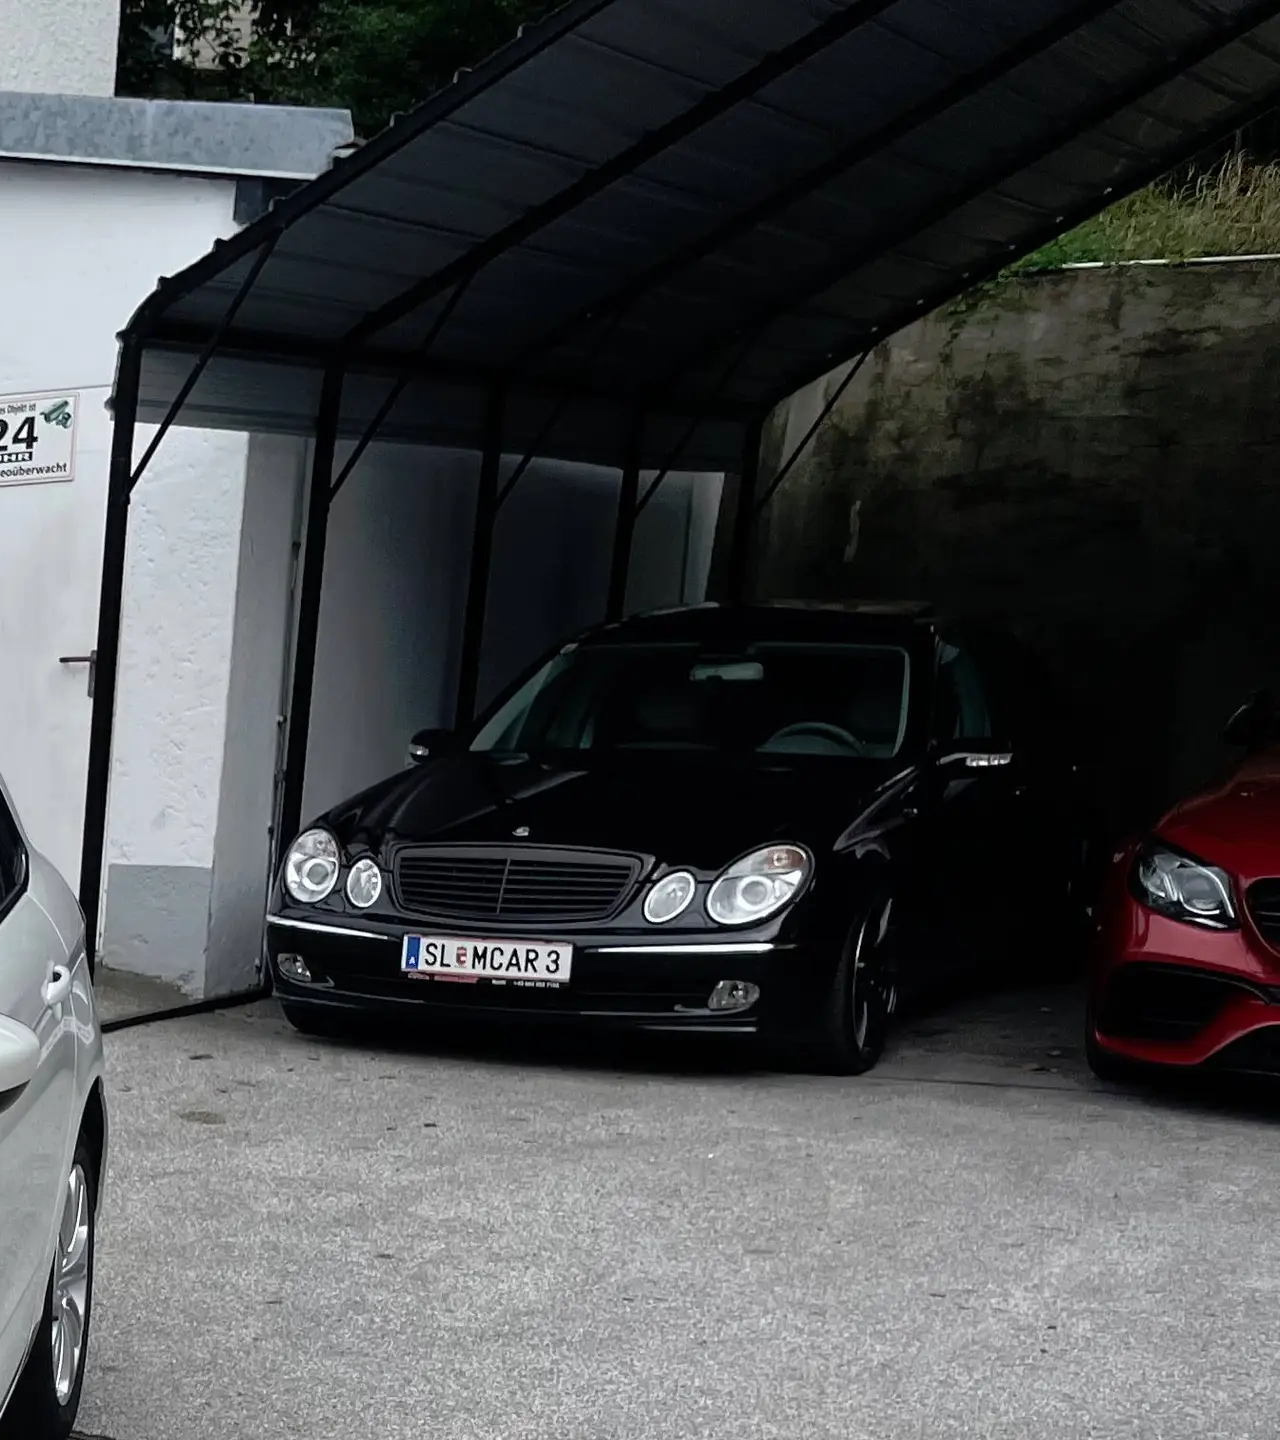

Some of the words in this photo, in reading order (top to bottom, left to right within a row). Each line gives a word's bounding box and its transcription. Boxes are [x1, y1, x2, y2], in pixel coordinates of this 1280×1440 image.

[408, 956, 416, 965] A
[424, 942, 451, 968] SL
[471, 945, 540, 974] MCAR
[545, 949, 561, 974] 3
